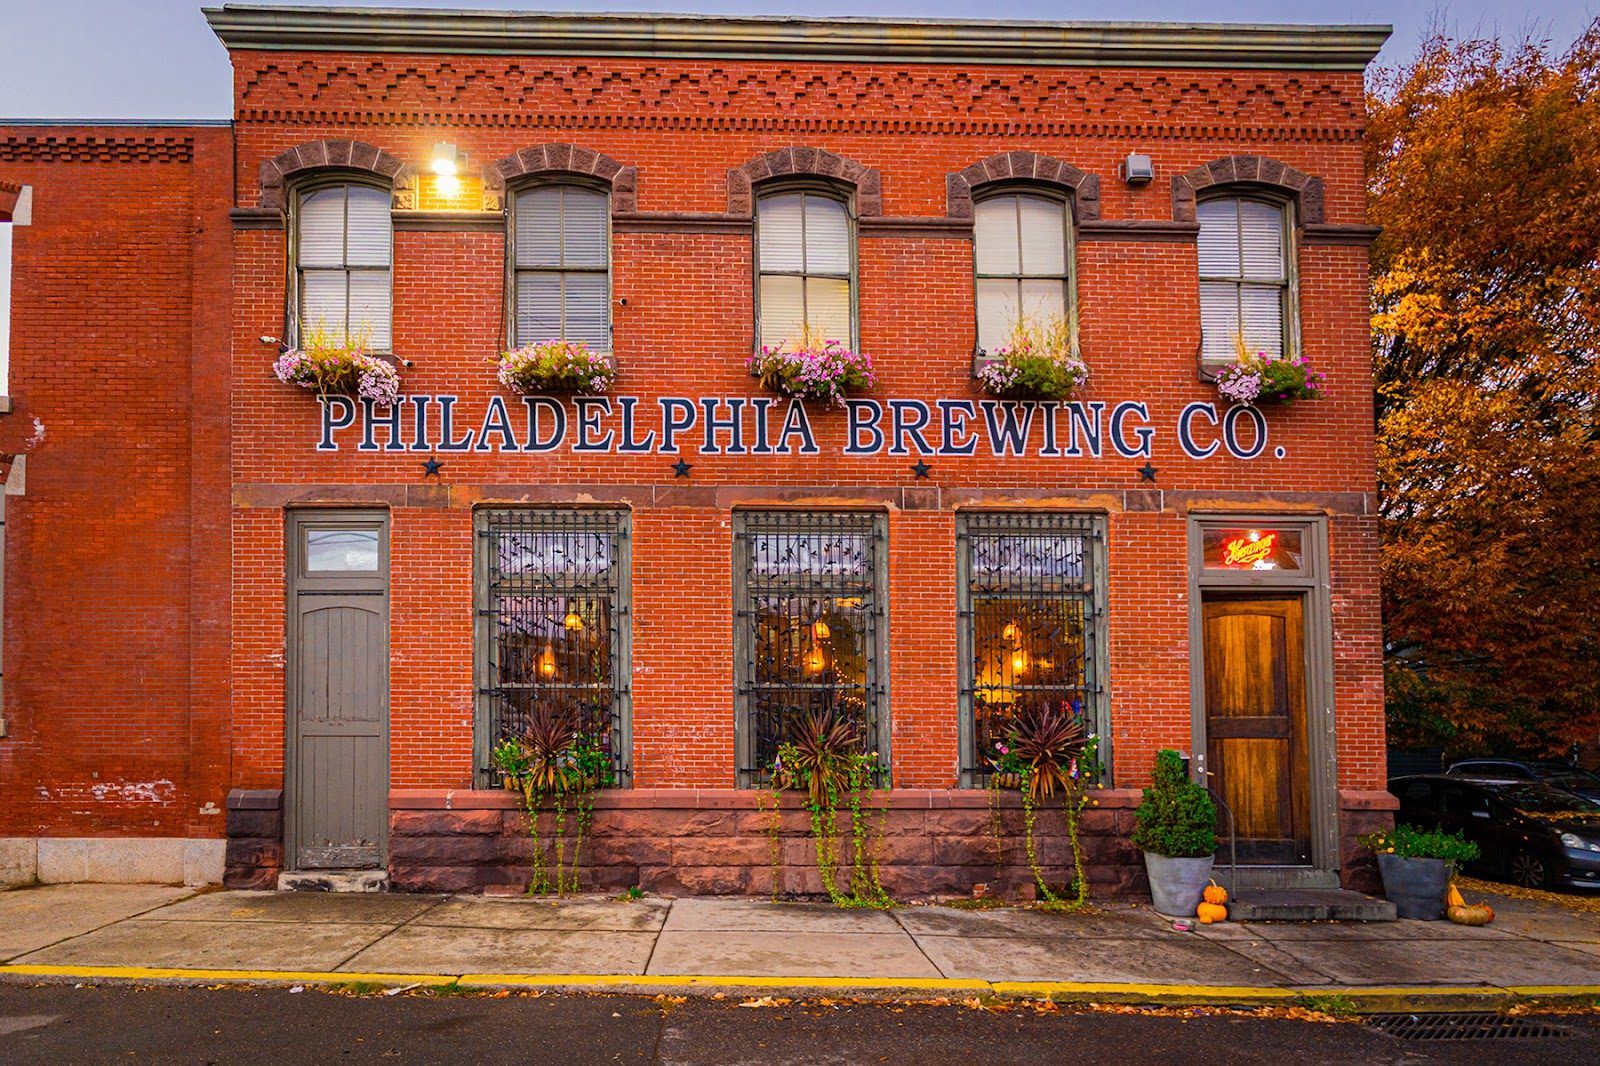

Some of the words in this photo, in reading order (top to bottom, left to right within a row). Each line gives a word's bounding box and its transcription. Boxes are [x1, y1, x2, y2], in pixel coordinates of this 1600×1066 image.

[316, 394, 820, 455] PHILADELPHIA
[843, 399, 1156, 459] BREWING
[1177, 402, 1286, 460] CO.
